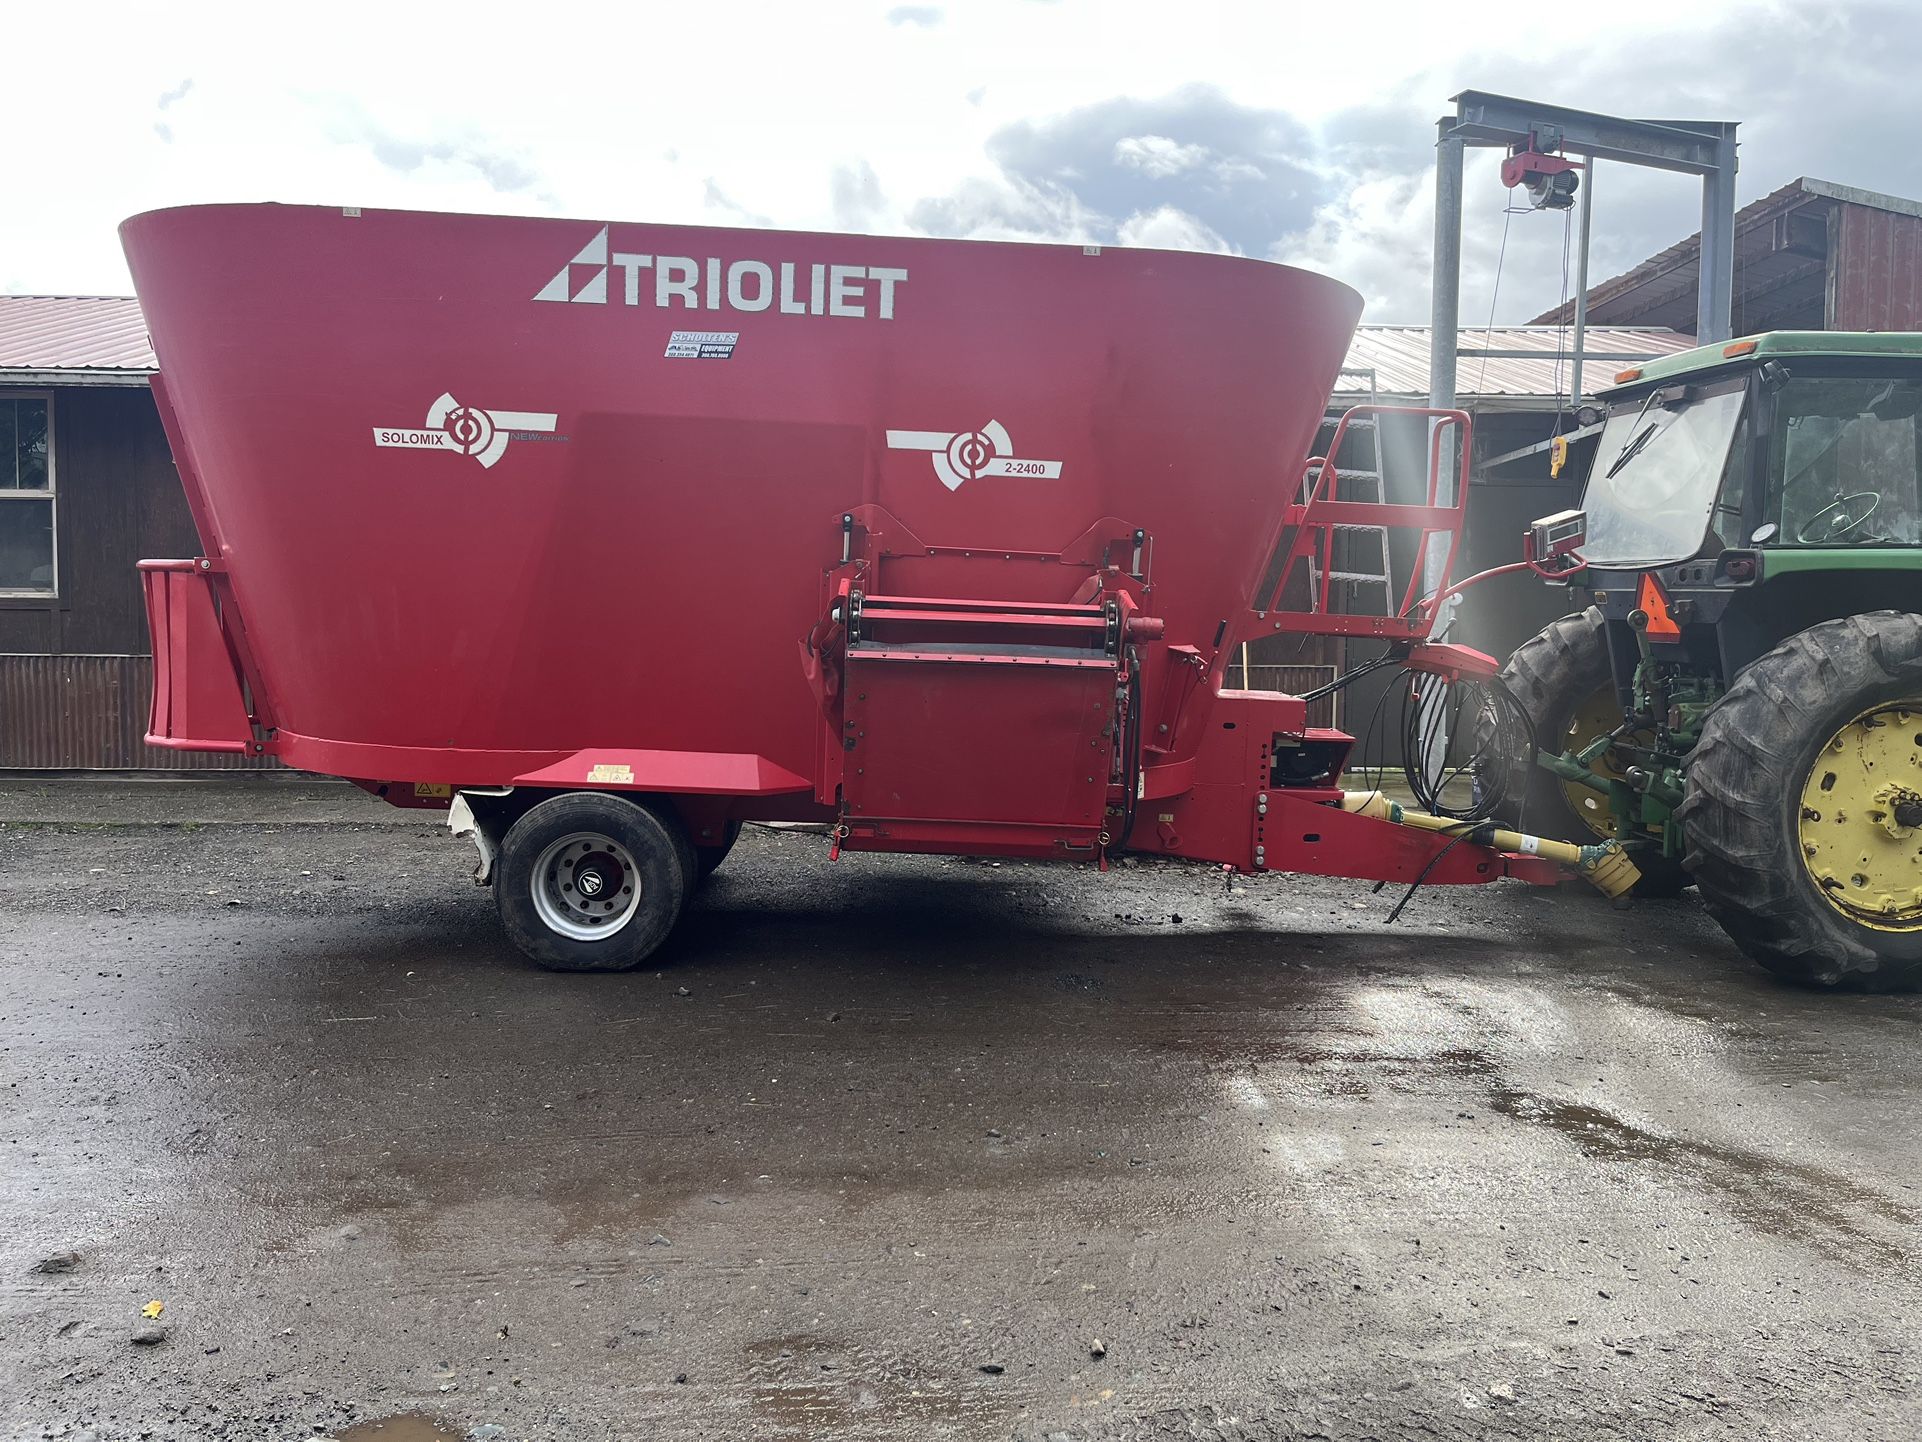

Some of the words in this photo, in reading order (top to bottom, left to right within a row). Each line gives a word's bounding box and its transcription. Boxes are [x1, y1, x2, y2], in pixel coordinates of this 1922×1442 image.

[612, 252, 908, 319] TRIOLIET
[381, 432, 444, 446] SOLOMIX
[510, 433, 537, 441] NEW
[1005, 462, 1045, 475] 2-2400
